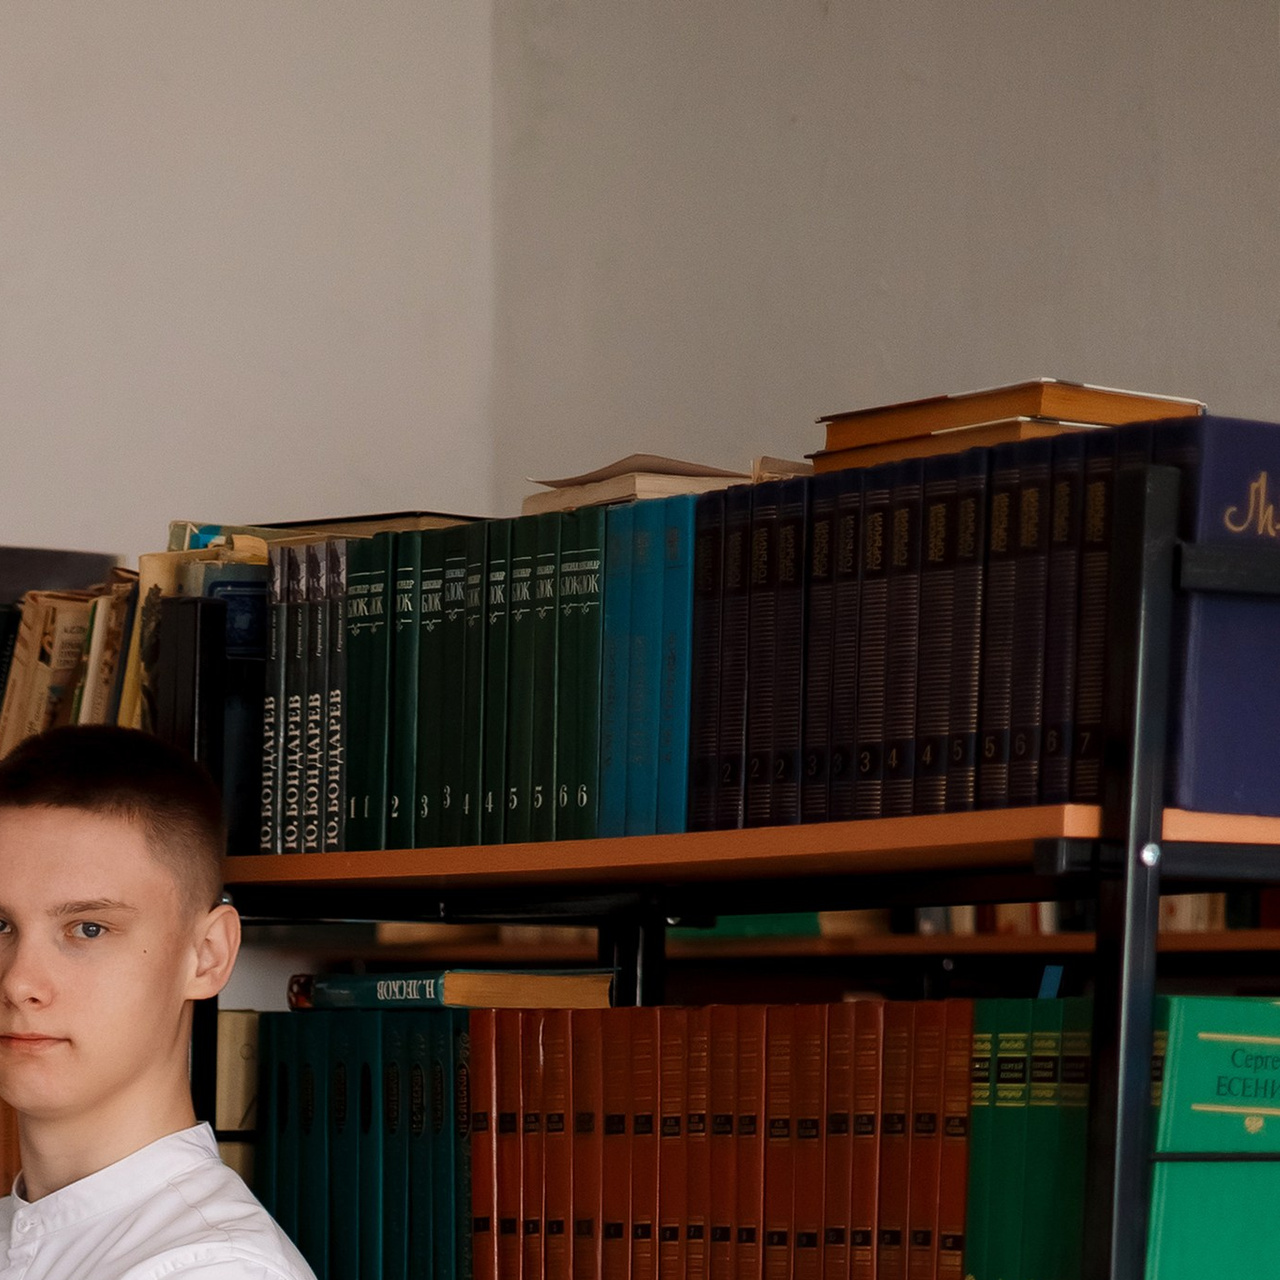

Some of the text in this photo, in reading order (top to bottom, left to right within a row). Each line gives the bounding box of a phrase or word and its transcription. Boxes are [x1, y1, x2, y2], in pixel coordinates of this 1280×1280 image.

[284, 694, 304, 849] Ю. БОНДАРЕВ
[304, 692, 323, 849] Ю. БОНДАРЕВ
[326, 689, 344, 845] Ю. БОНДАРЕВ
[391, 795, 399, 817] 2
[421, 794, 428, 818] 3
[443, 785, 451, 808] 3
[485, 791, 493, 812] 4
[509, 787, 517, 810] 5
[534, 786, 542, 808] 5
[559, 784, 568, 807] 6
[577, 784, 587, 807] 6
[1230, 1047, 1280, 1071] Серге
